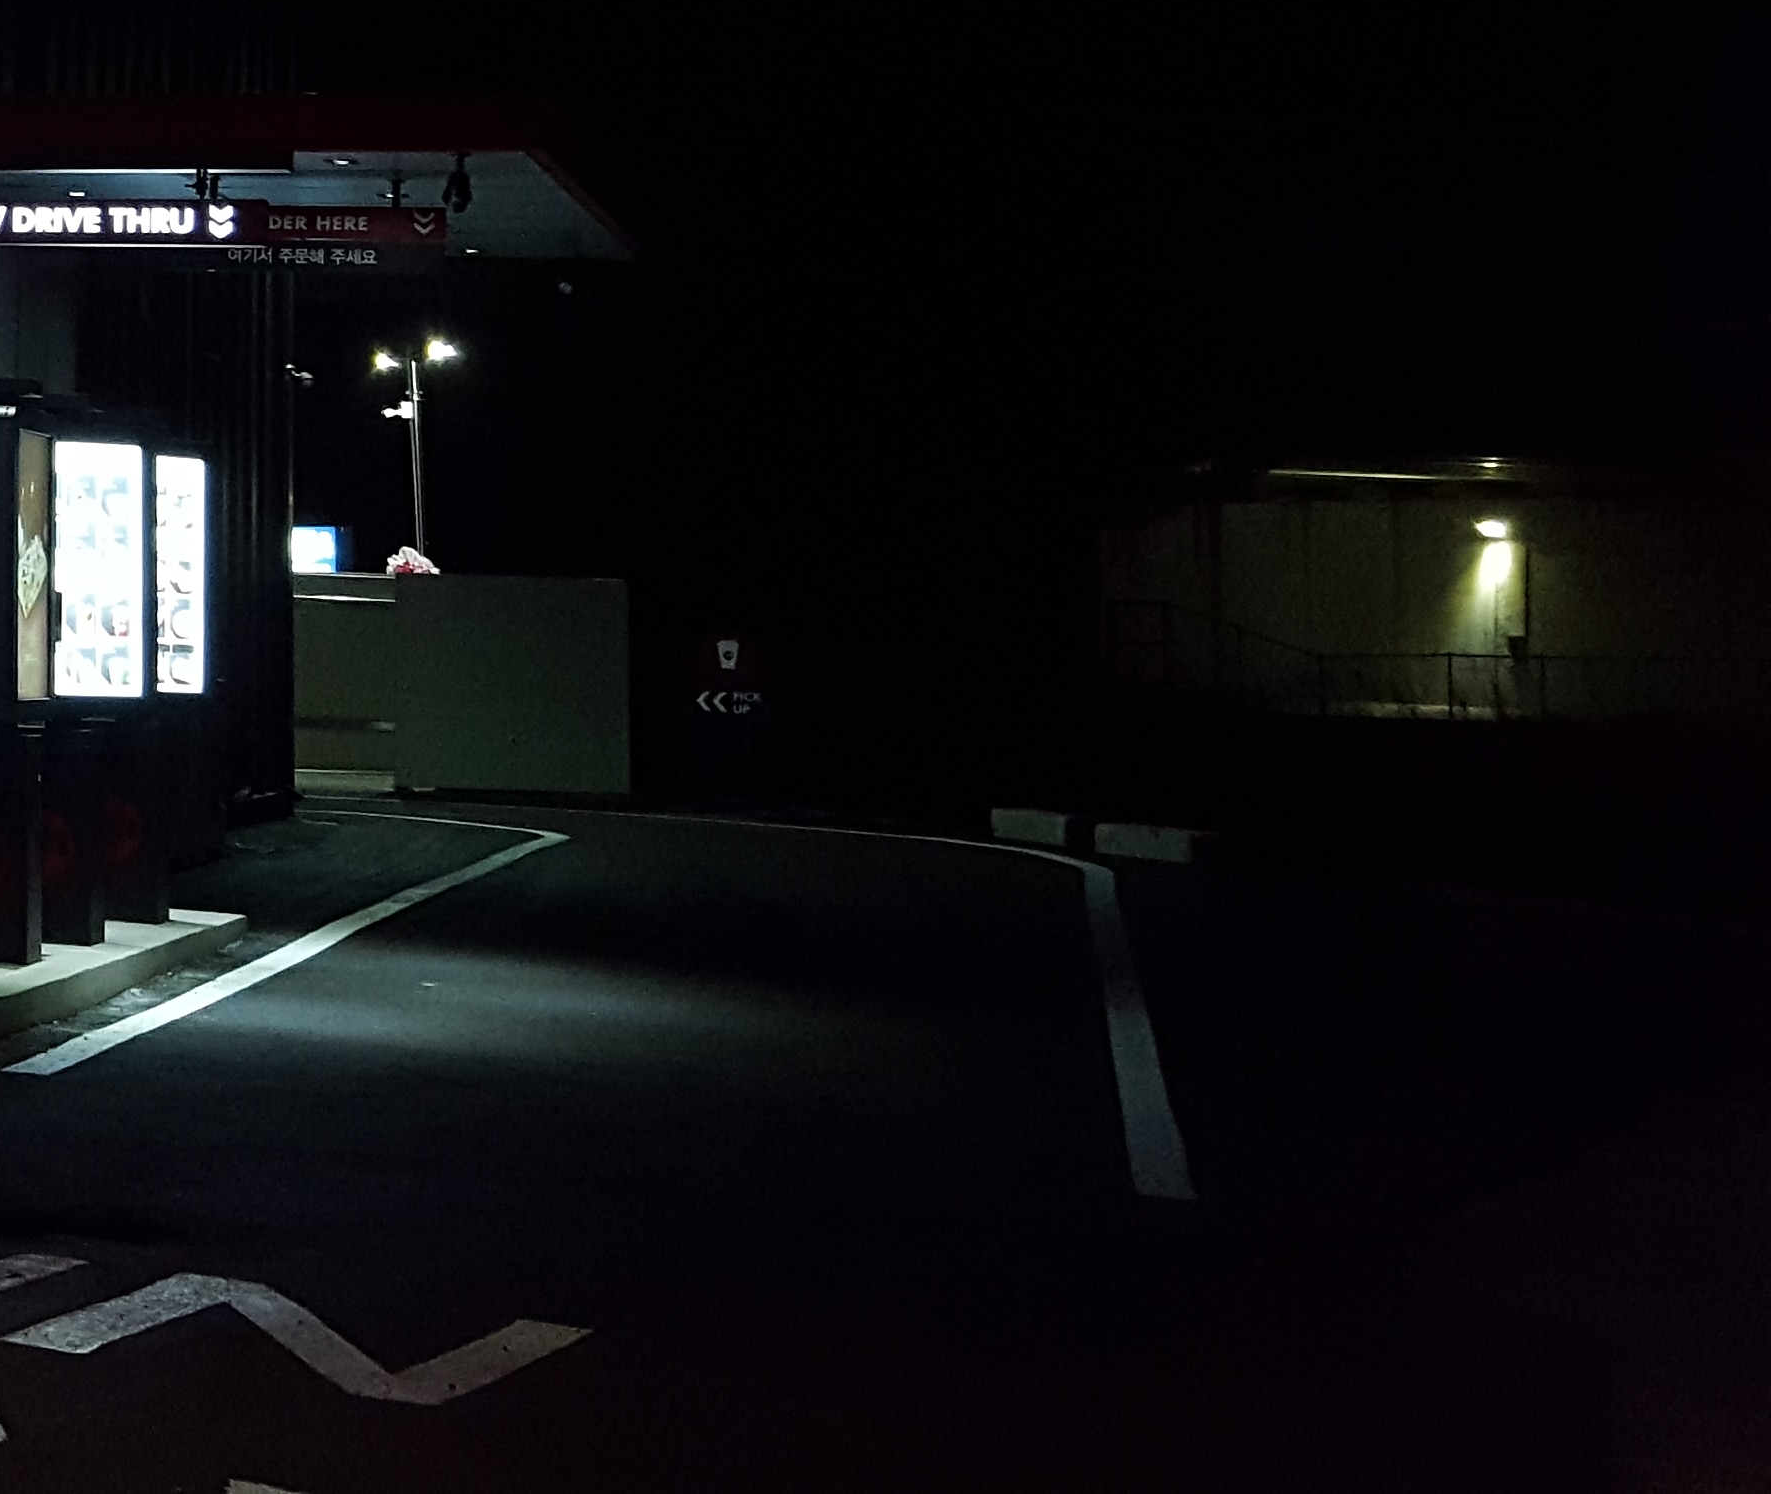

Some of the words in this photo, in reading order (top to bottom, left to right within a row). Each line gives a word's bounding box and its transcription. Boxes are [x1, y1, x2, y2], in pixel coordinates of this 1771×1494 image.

[11, 206, 101, 235] DRIVE
[107, 207, 195, 236] THRU
[268, 214, 308, 230] DER
[316, 215, 369, 232] HERE
[227, 246, 273, 264] 여기서
[278, 247, 324, 265] 주문해
[329, 248, 378, 265] 주세요
[732, 704, 751, 715] UP
